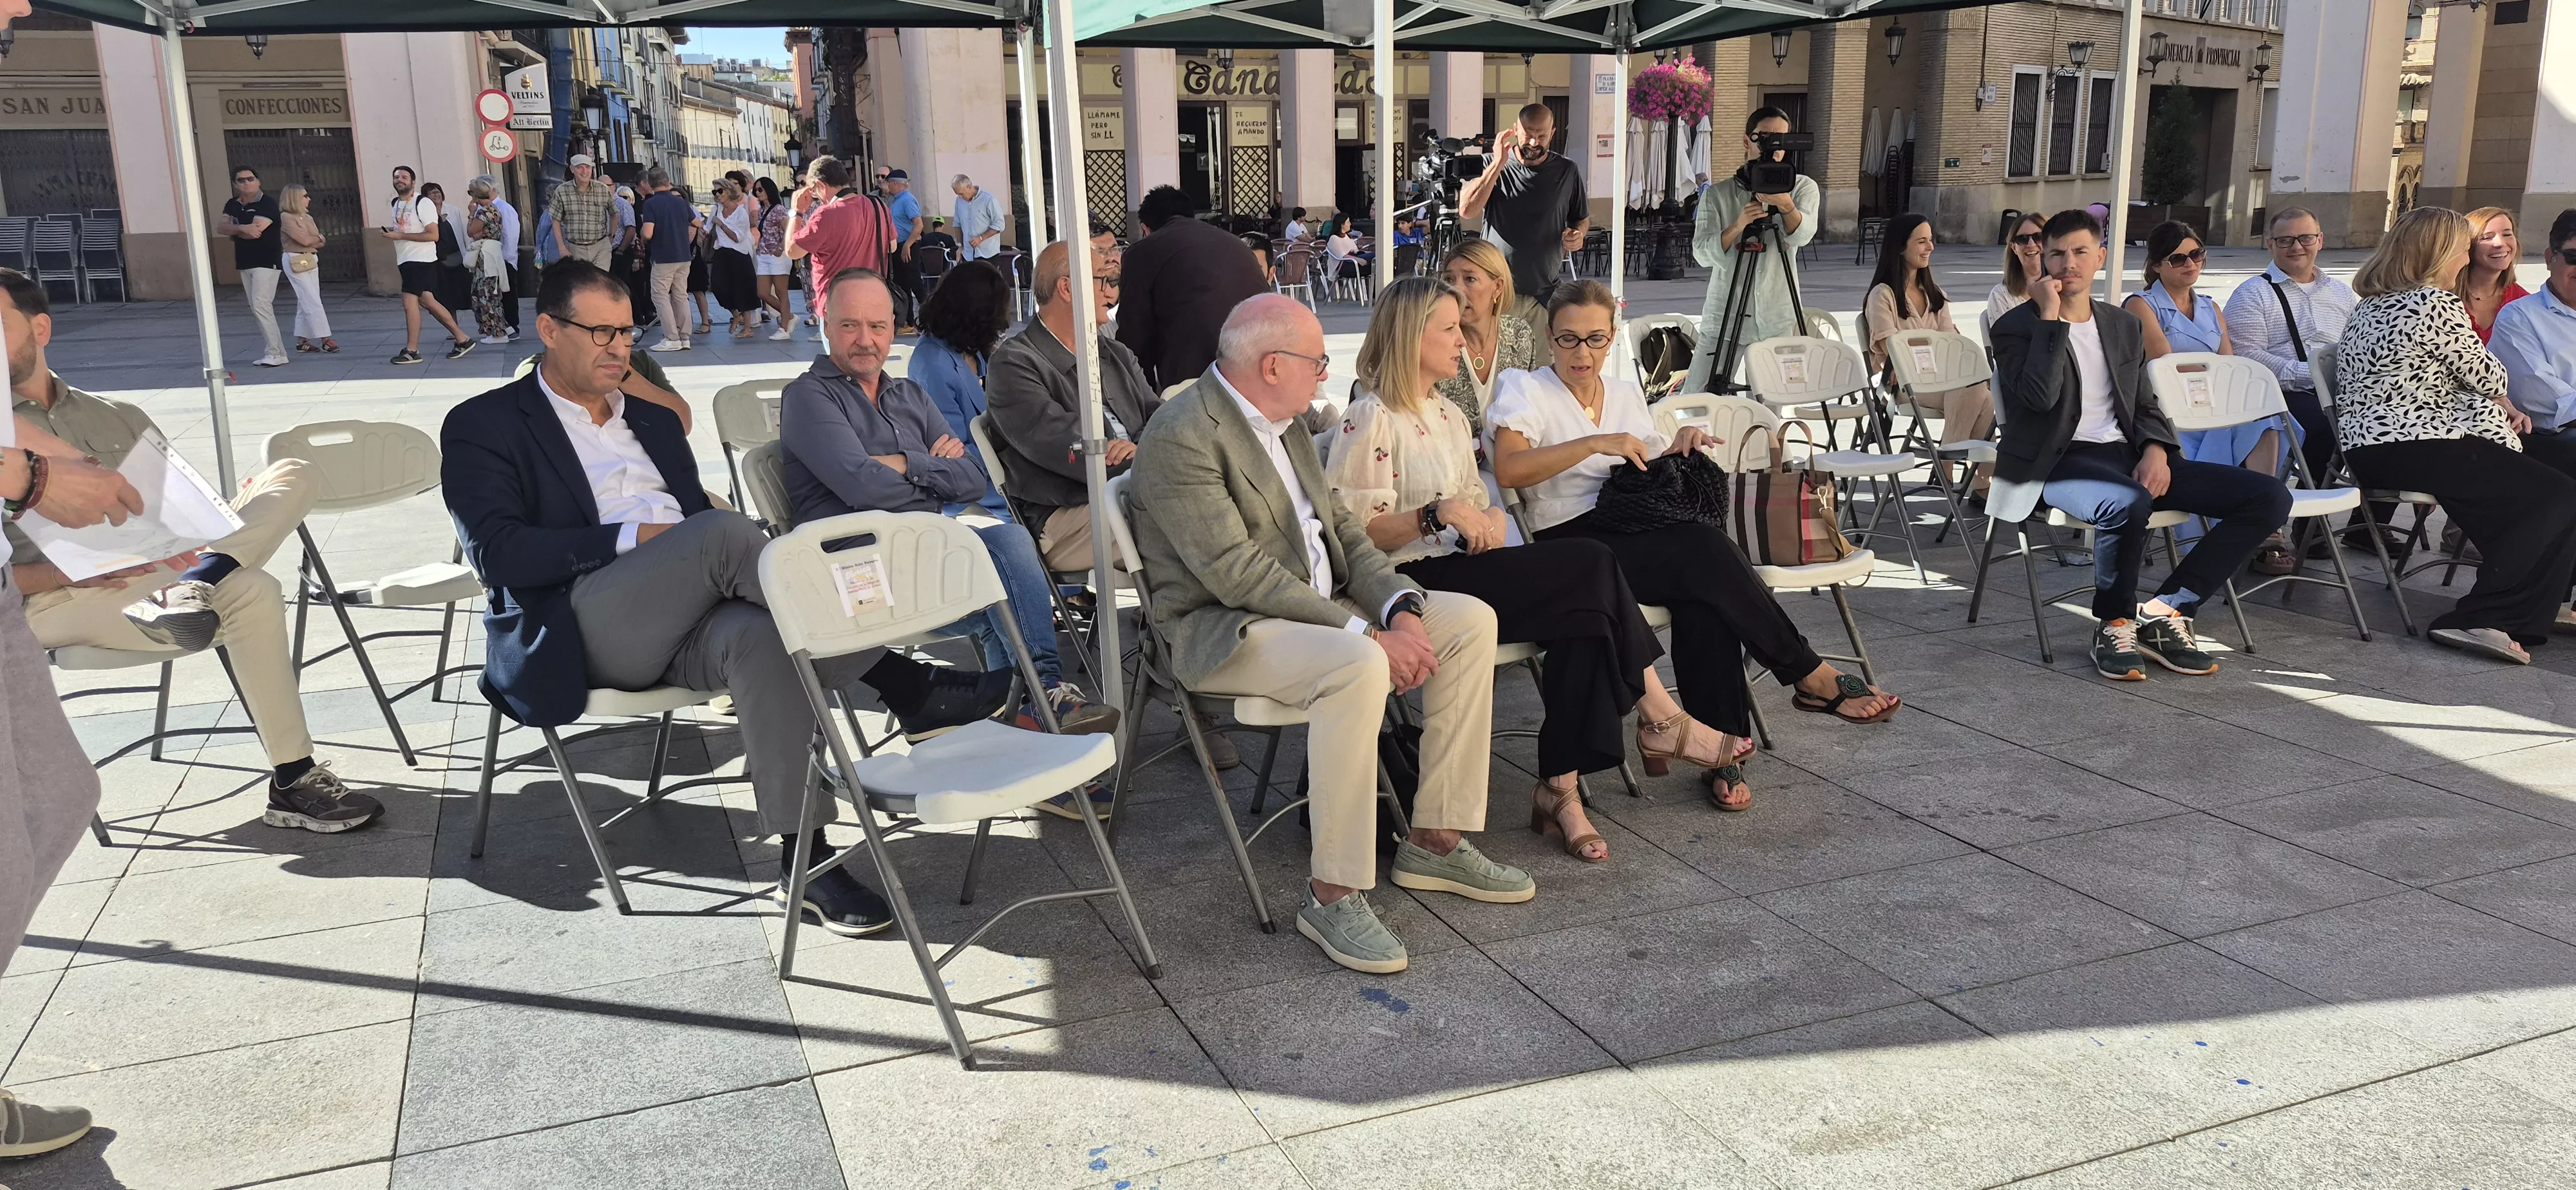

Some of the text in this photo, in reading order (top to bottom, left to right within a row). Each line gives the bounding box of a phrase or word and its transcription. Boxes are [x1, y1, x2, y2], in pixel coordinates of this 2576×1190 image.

[2164, 42, 2241, 68] DIENCIA PROVINCIAL
[2, 97, 107, 115] SAN JUA
[225, 97, 343, 115] CONFECCIONES
[1088, 109, 1121, 119] LLÁMAME
[1104, 130, 1114, 139] LL
[1087, 321, 1101, 404] HUESCA
